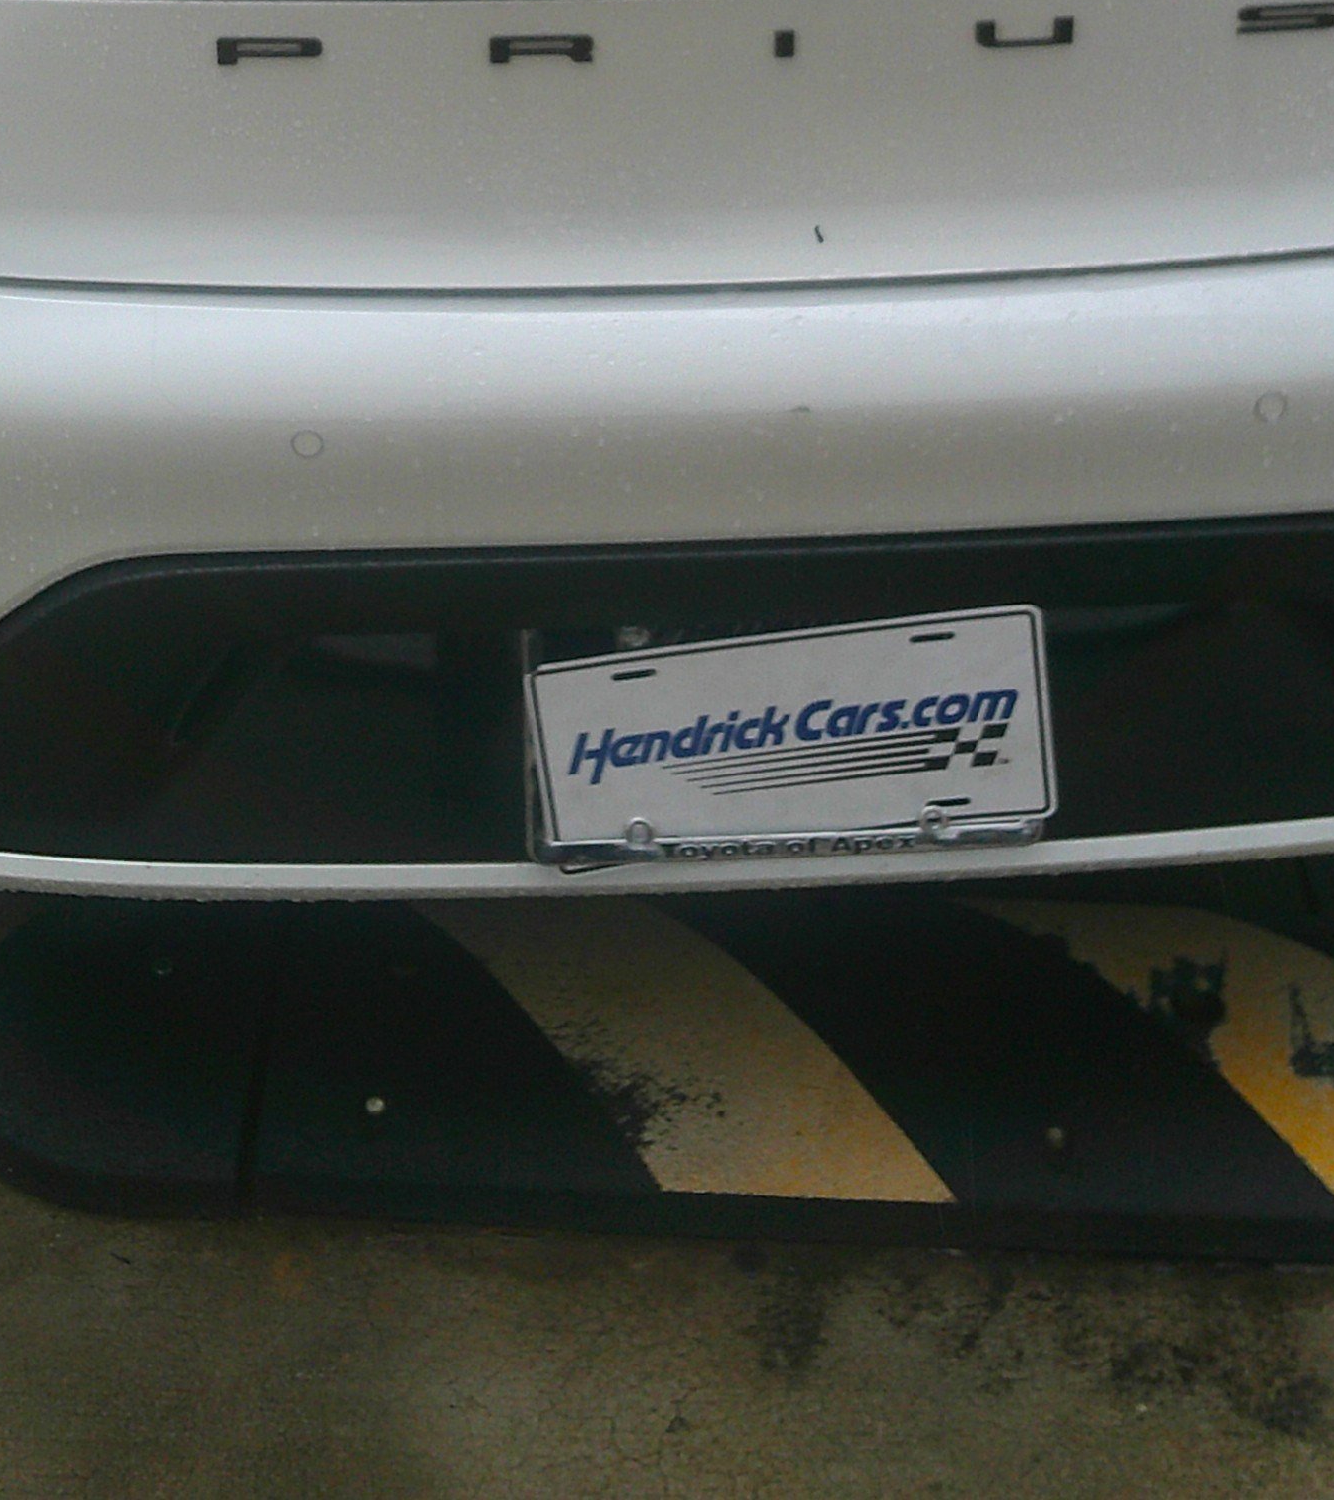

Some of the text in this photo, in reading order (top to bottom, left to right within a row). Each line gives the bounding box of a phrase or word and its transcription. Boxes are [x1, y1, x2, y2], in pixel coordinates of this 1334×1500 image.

[663, 833, 917, 860] Toyota of Apex
